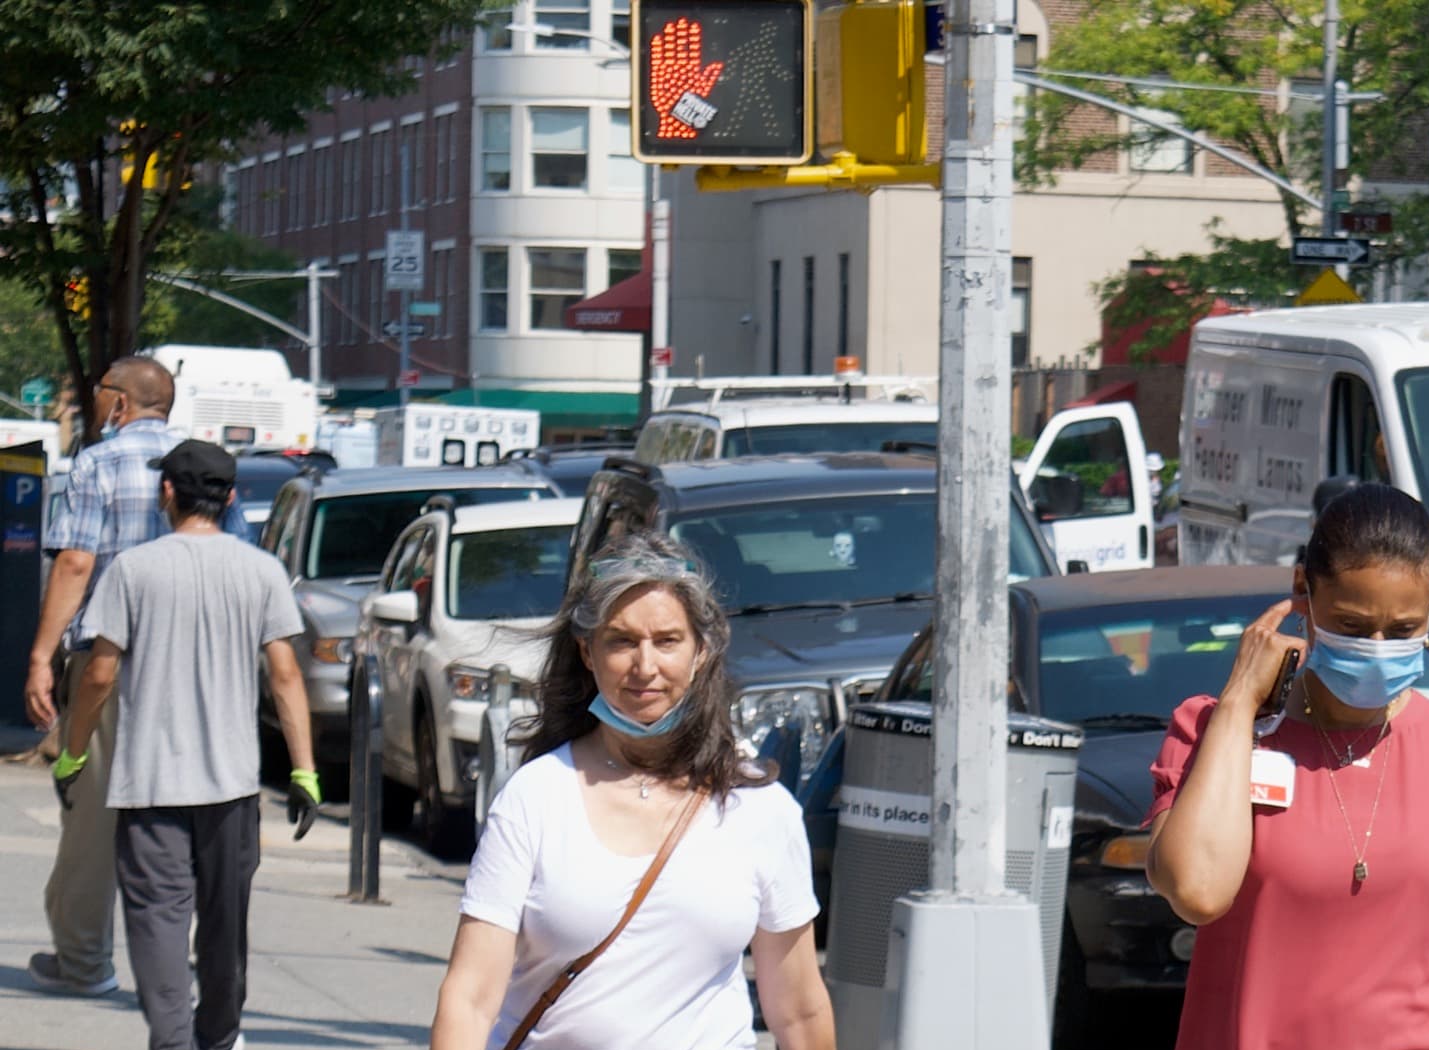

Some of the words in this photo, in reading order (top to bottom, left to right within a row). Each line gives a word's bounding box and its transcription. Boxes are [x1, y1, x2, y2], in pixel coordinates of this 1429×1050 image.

[391, 256, 417, 272] 25
[1260, 383, 1304, 430] Mirror
[16, 477, 34, 504] P
[883, 806, 929, 824] place
